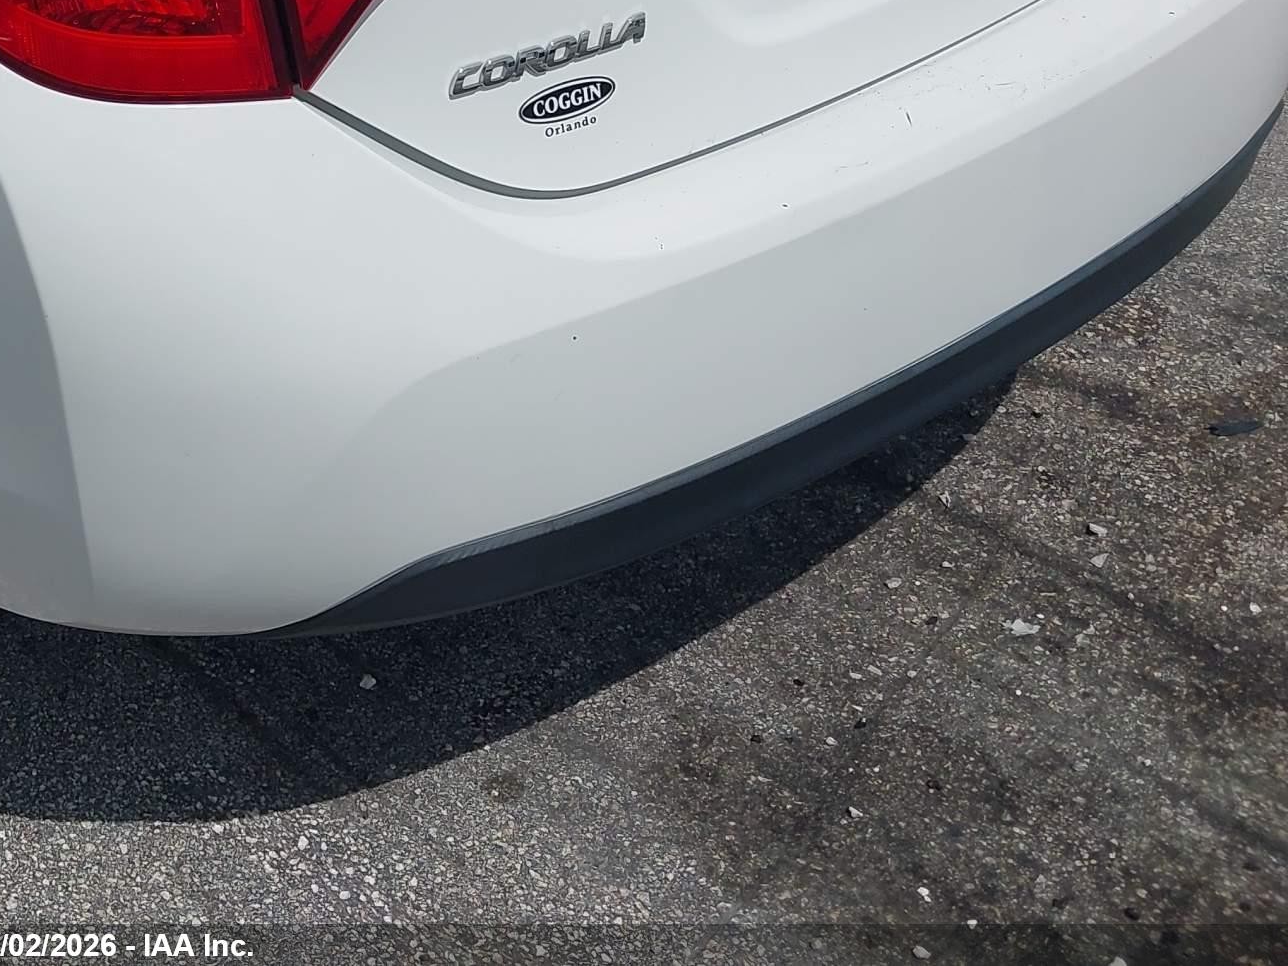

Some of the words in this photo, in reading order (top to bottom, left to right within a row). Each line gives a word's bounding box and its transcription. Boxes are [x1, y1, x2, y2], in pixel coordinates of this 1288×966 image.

[448, 11, 646, 101] COROLLA
[531, 82, 603, 118] COGGIN
[544, 115, 598, 138] Orlando
